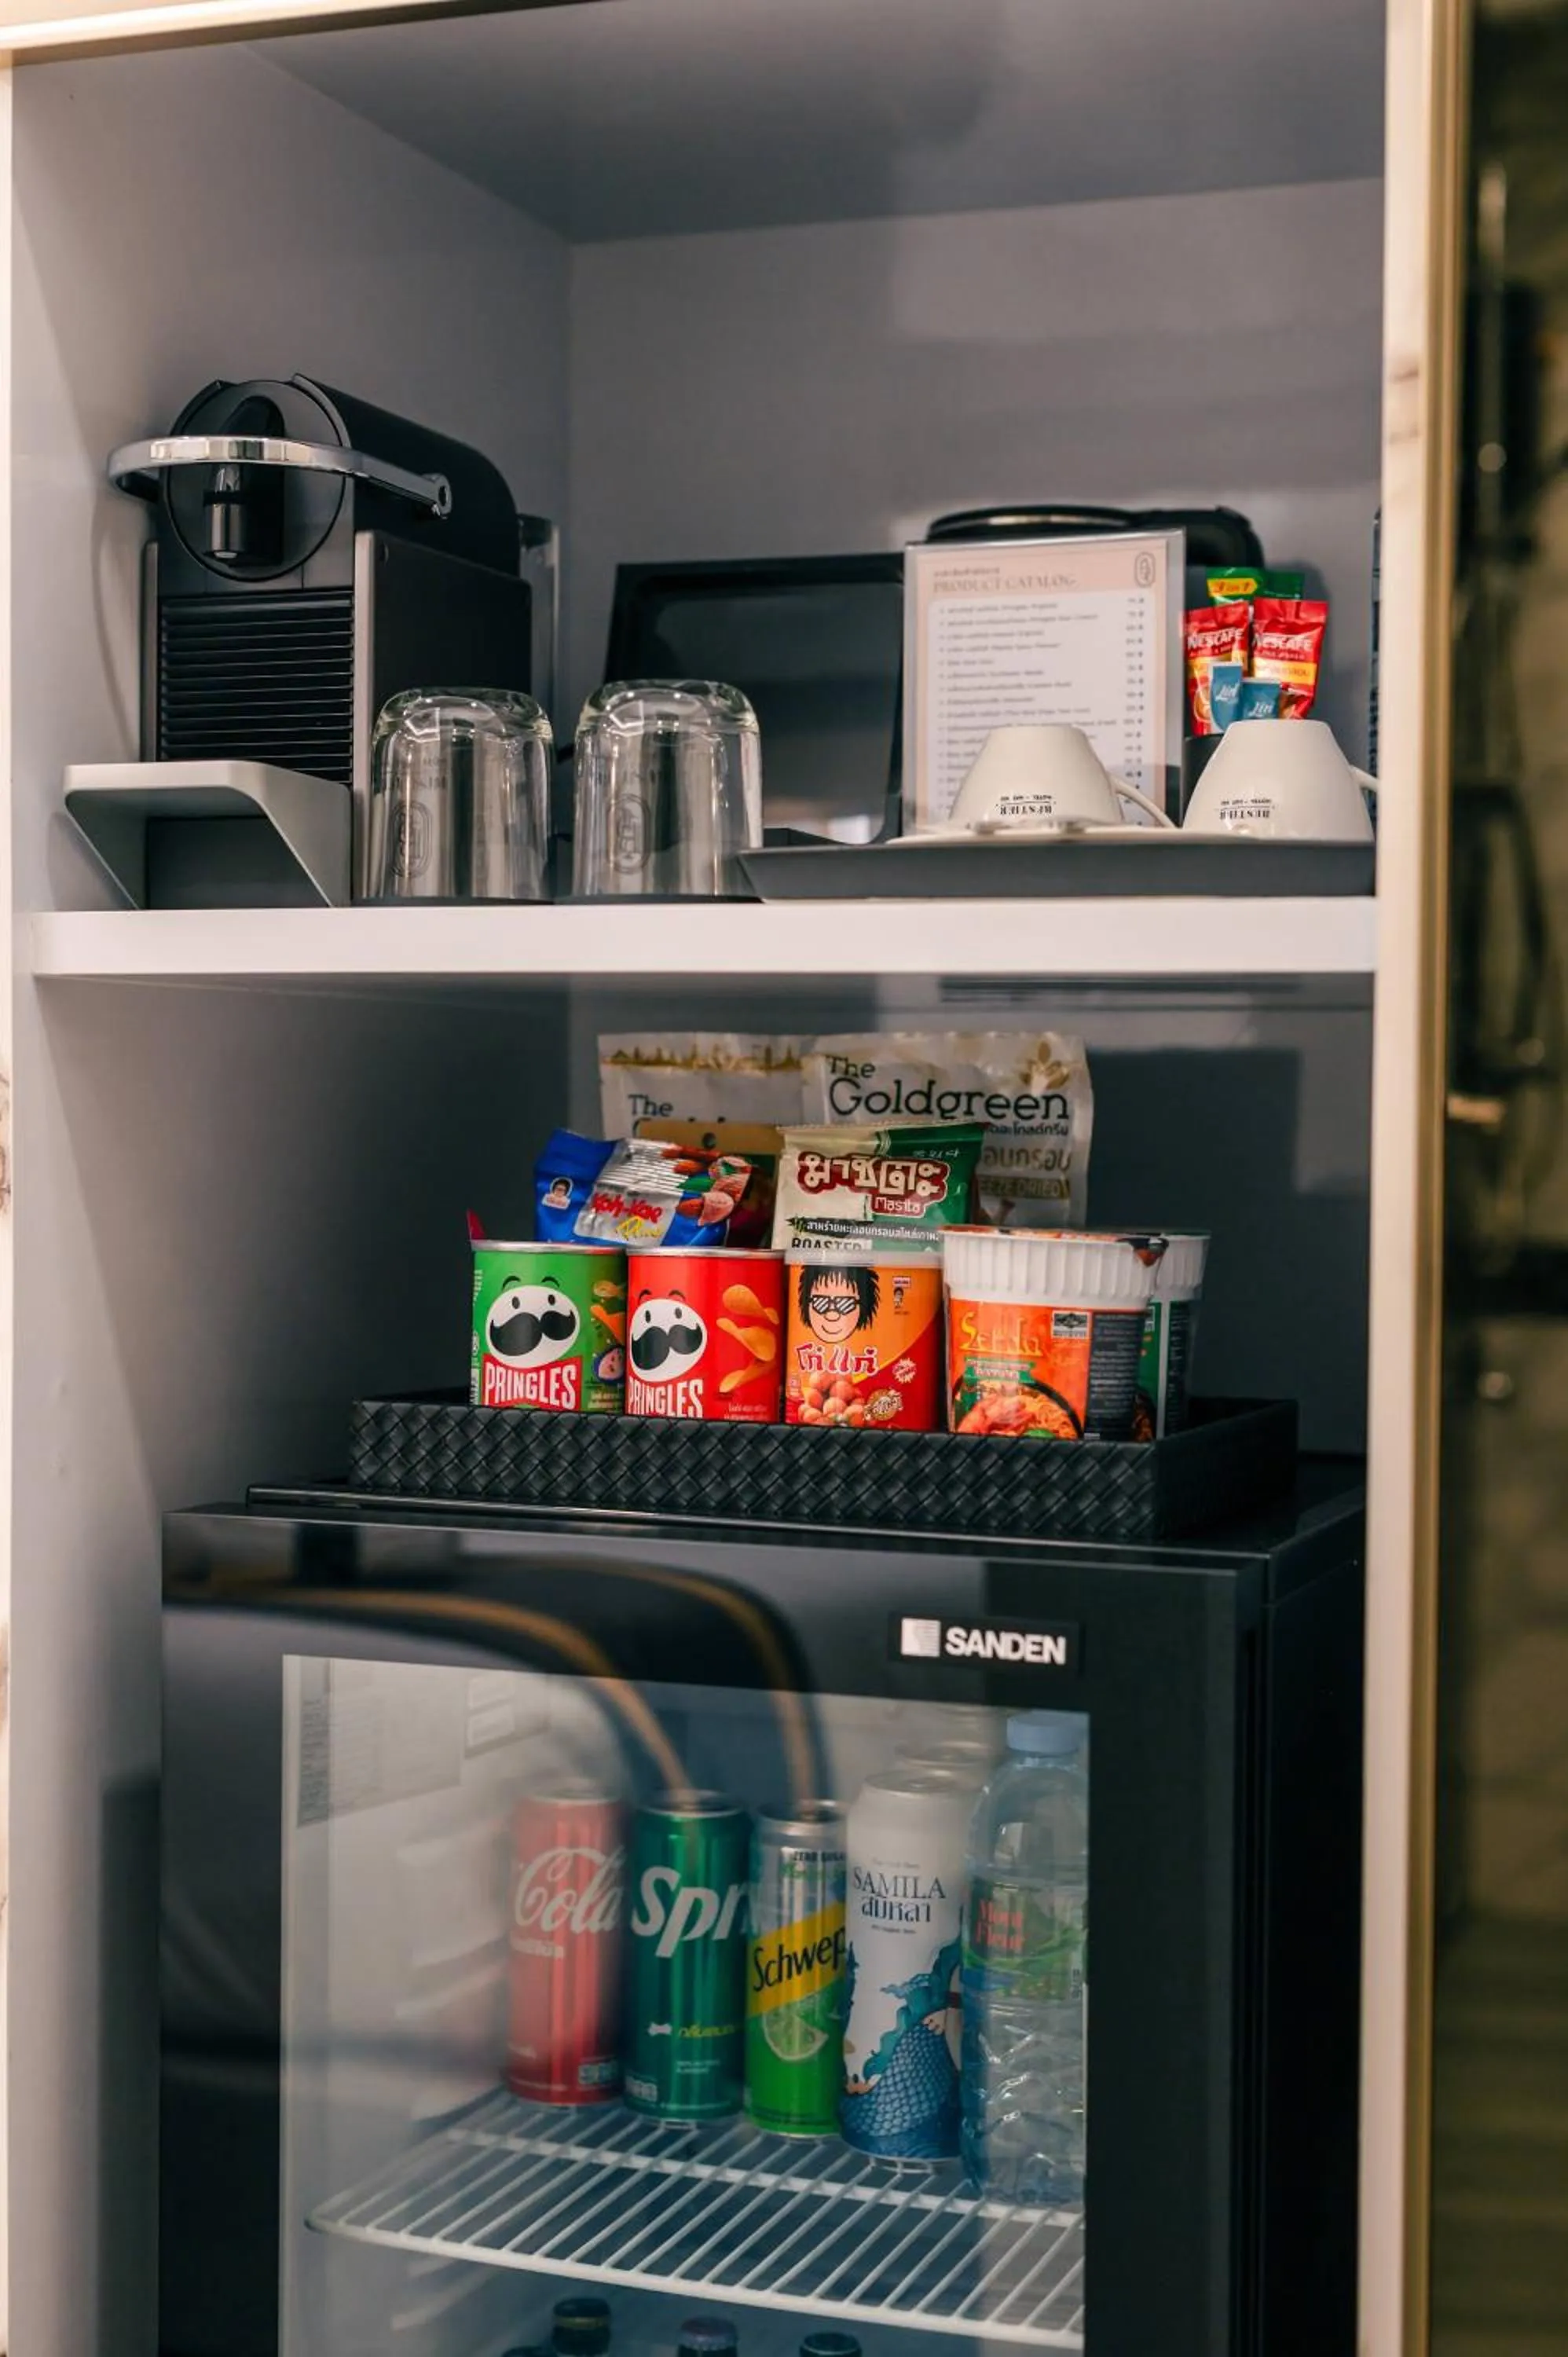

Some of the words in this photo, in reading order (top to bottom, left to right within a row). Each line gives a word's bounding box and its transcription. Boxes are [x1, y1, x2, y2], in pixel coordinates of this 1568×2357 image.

[826, 1055, 875, 1077] The
[628, 1094, 673, 1117] The
[830, 1077, 1069, 1120] Goldgreen
[874, 1196, 921, 1214] Masita
[484, 1361, 577, 1410] PRINGLES
[628, 1376, 704, 1419] PRINGLES
[945, 1626, 1067, 1665] SANDEN
[852, 1866, 947, 1899] SAMILA
[631, 1865, 748, 1958] Spr
[753, 1925, 846, 1992] Schwep
